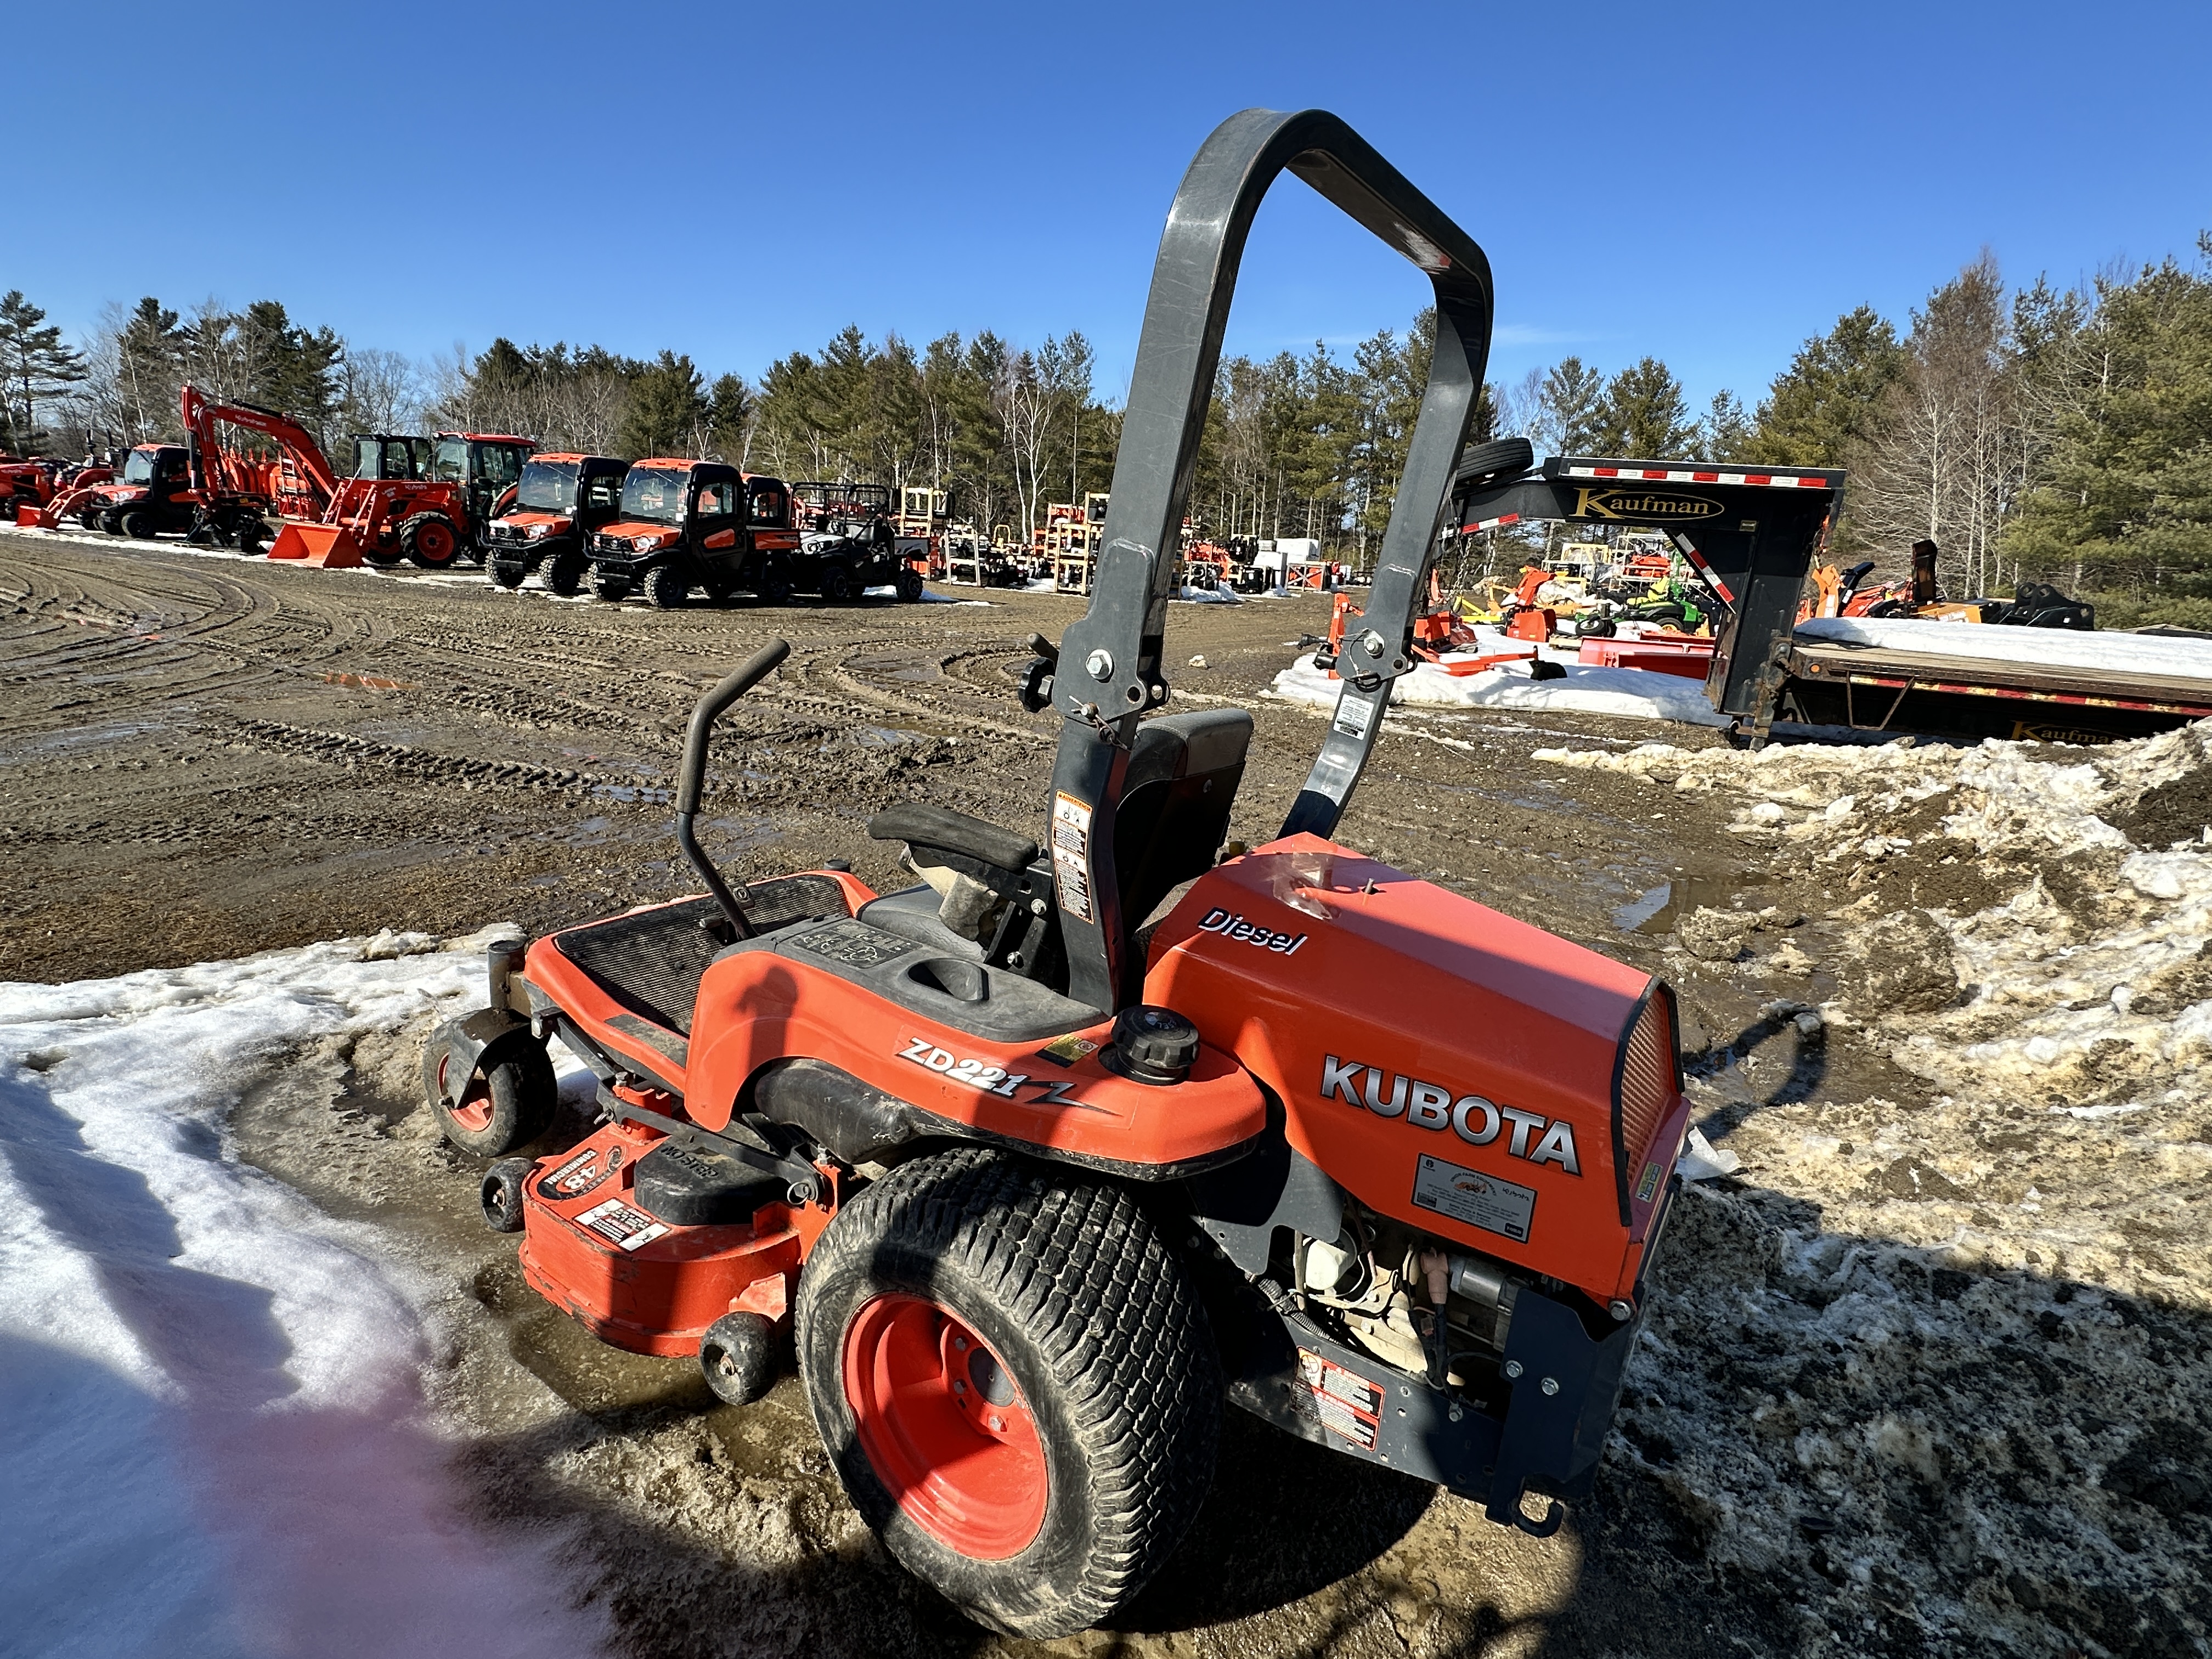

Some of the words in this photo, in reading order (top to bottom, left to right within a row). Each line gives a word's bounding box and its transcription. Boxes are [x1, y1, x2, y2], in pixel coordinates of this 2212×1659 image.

[1568, 487, 1709, 520] Kaufman
[2010, 720, 2117, 744] Kaufma
[1197, 906, 1308, 956] Diesel
[894, 1037, 1031, 1097] ZD221
[1321, 1053, 1582, 1177] KUBOTA
[544, 1150, 596, 1185] COMMERCIAL
[565, 1165, 596, 1189] 48
[1502, 1187, 1530, 1201] Kubota
